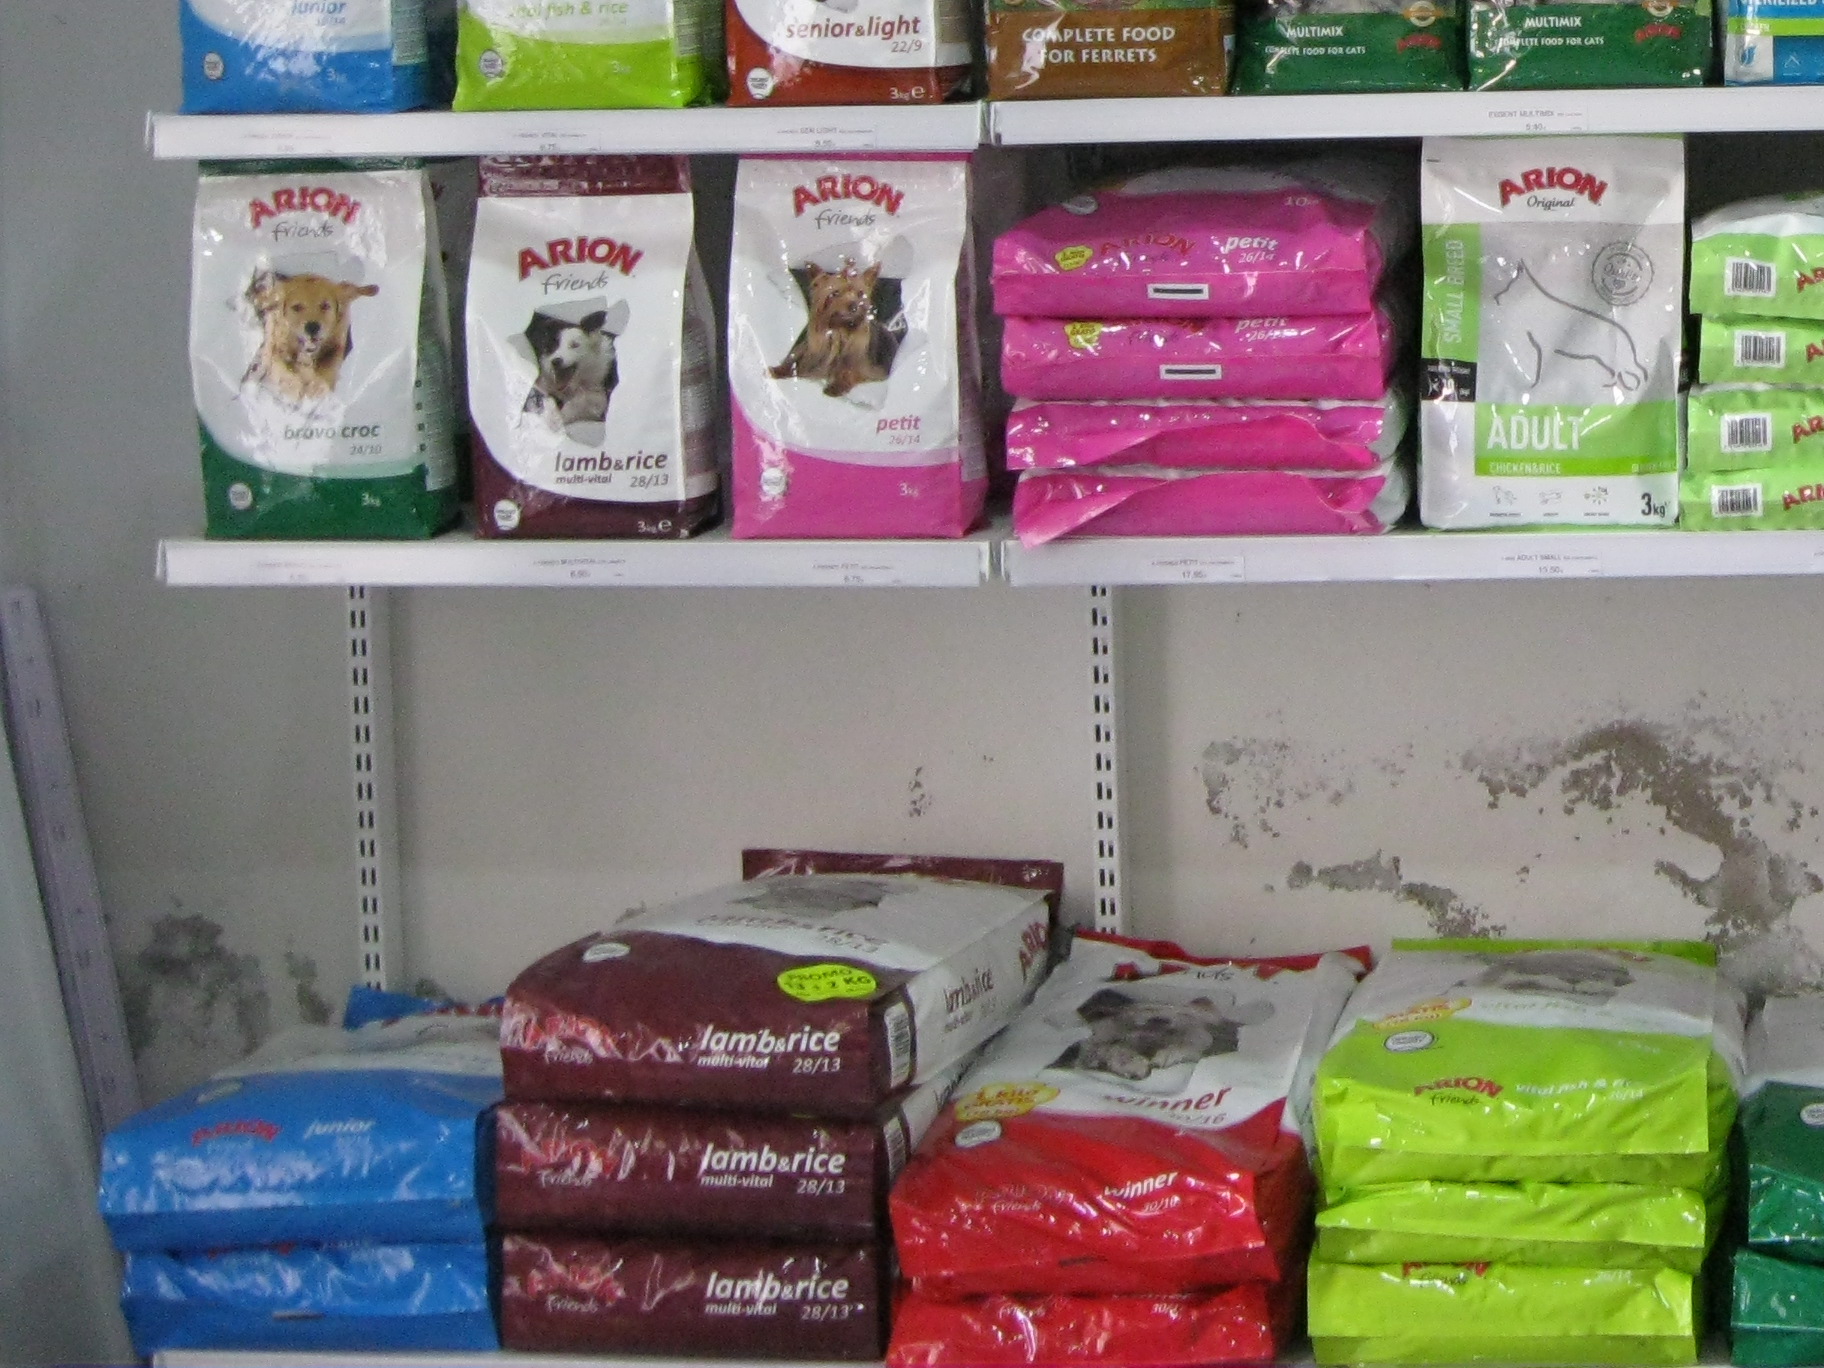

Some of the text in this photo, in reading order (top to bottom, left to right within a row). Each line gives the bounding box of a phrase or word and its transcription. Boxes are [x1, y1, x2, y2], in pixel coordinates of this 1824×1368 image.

[1285, 26, 1344, 38] MULTIMIX
[1525, 16, 1582, 29] MULTIMIX
[1022, 26, 1176, 43] COMPLETE FOOD
[1541, 35, 1605, 47] FOOD CATS
[891, 39, 922, 54] 22/9
[1040, 47, 1157, 63] FOR FERRETS
[1302, 45, 1367, 57] FOOD FOR CATS
[792, 173, 904, 216] ARION
[1498, 166, 1609, 206] ARION
[249, 186, 361, 228] ARION
[1526, 195, 1575, 211] Original
[814, 209, 876, 229] friends
[1223, 234, 1279, 254] petit
[518, 236, 644, 280] ARION
[542, 274, 609, 295] friends
[1234, 317, 1289, 334] petit
[1443, 291, 1463, 344] SMALL
[340, 424, 379, 439] croc
[876, 416, 921, 434] petit
[1487, 414, 1585, 451] ADULT
[556, 473, 669, 488] multi-vital 28/13
[1640, 491, 1667, 518] 3kg
[699, 1025, 841, 1053] lamb&rice
[793, 1057, 842, 1073] 28/13
[304, 1118, 376, 1140] junior
[702, 1144, 846, 1174] lamb&rice
[701, 1174, 846, 1194] multi-vital 28/13
[1105, 1171, 1179, 1199] winner
[705, 1270, 850, 1300] lamb&rice
[705, 1301, 850, 1320] multi-vital 28/13
